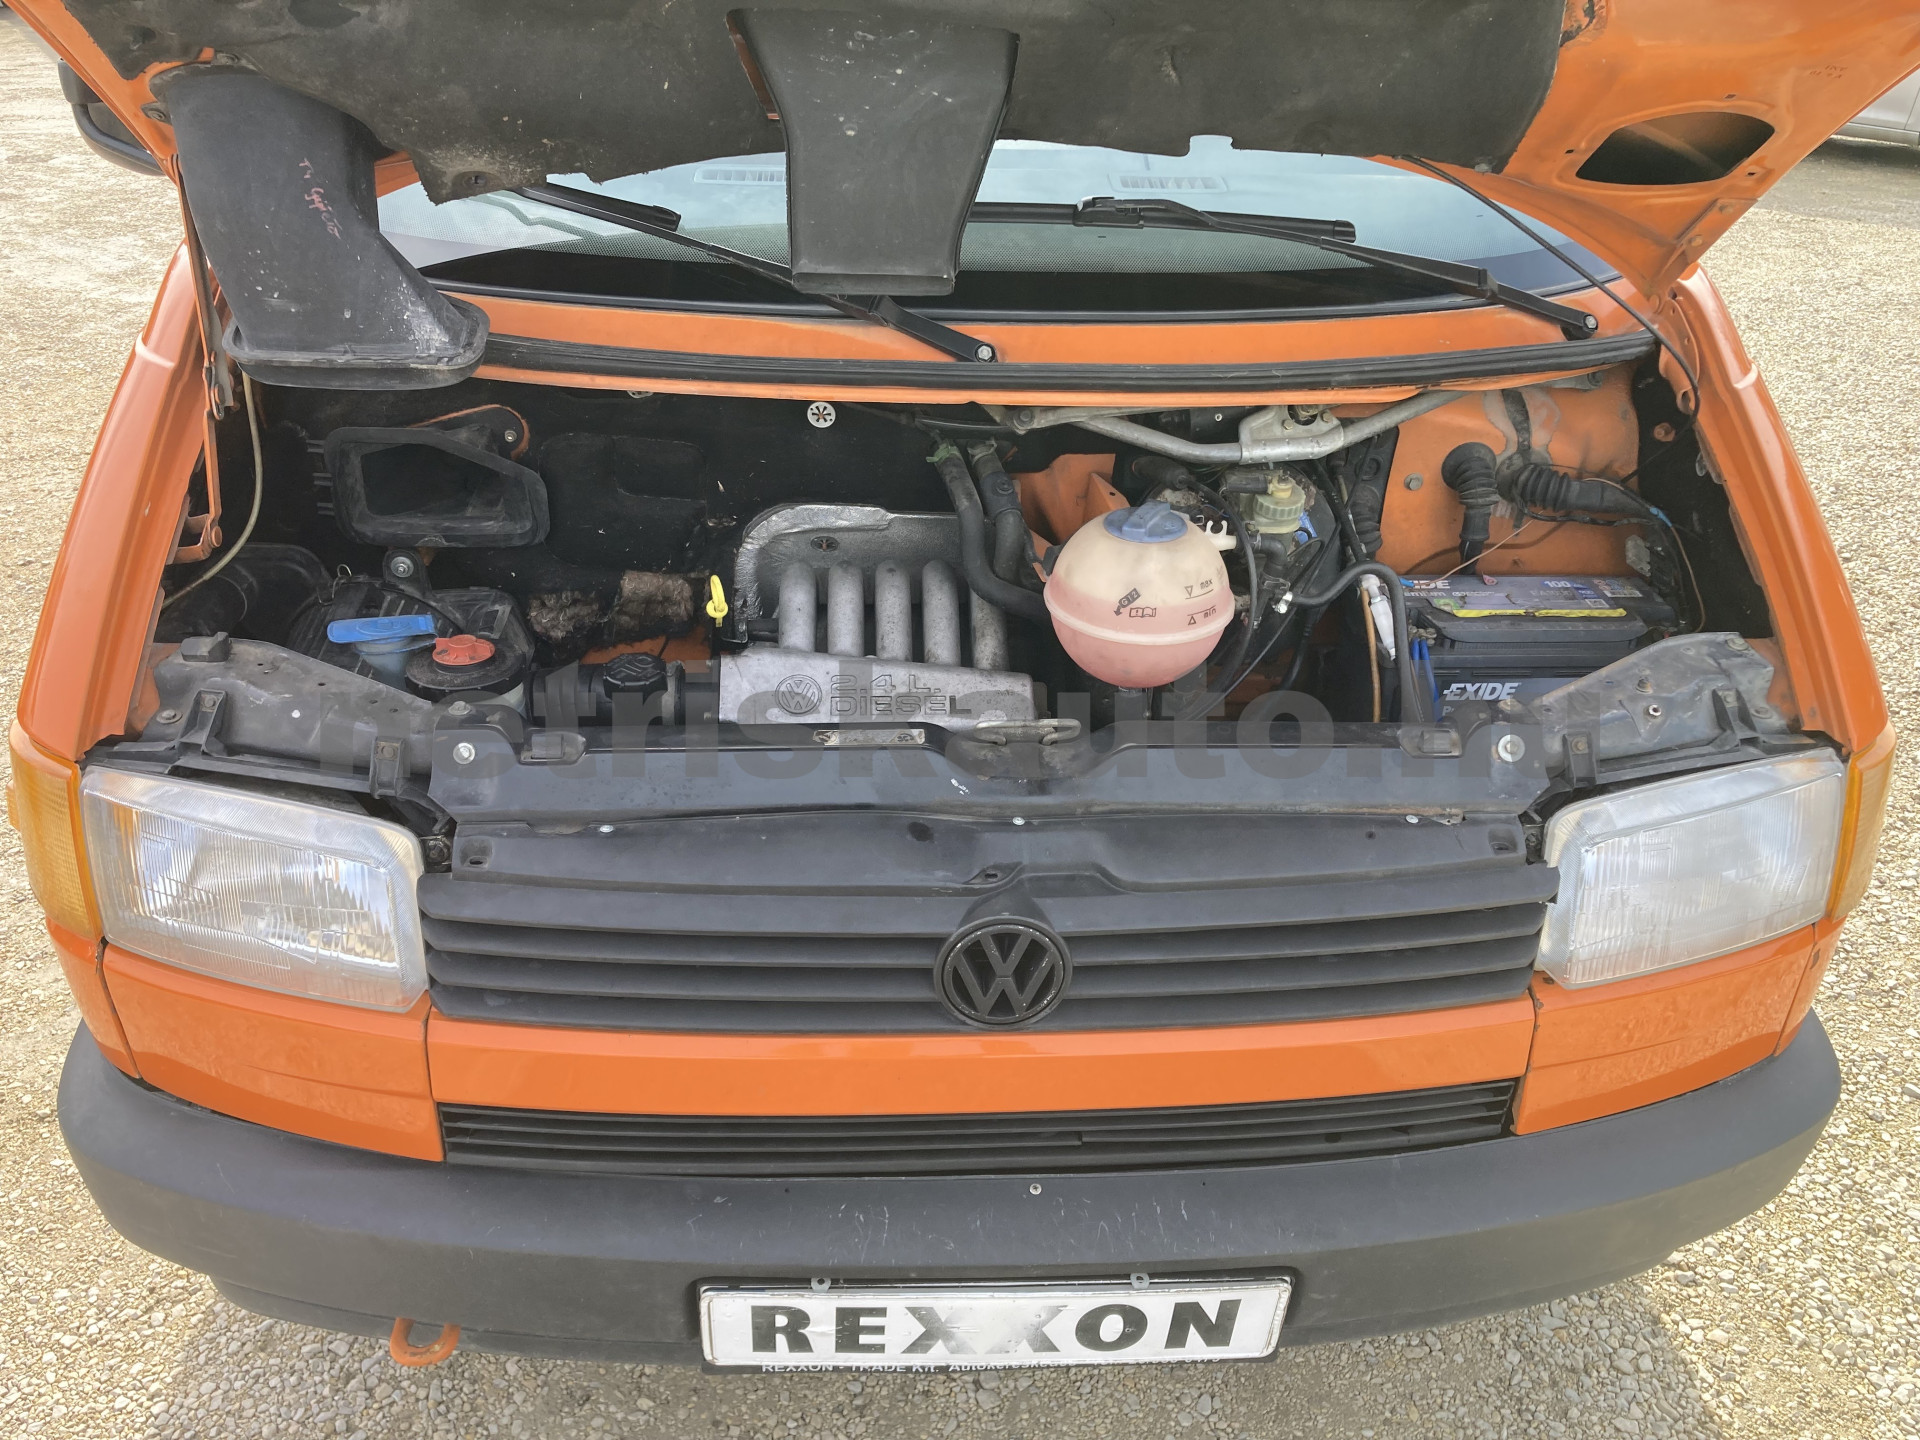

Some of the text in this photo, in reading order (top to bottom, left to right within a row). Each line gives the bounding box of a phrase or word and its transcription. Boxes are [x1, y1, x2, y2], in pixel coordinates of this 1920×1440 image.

[1544, 580, 1571, 588] 100
[1121, 590, 1139, 606] G12
[830, 674, 896, 693] 2.4
[1443, 682, 1519, 701] EXIDE
[751, 1299, 1242, 1354] REXXON
